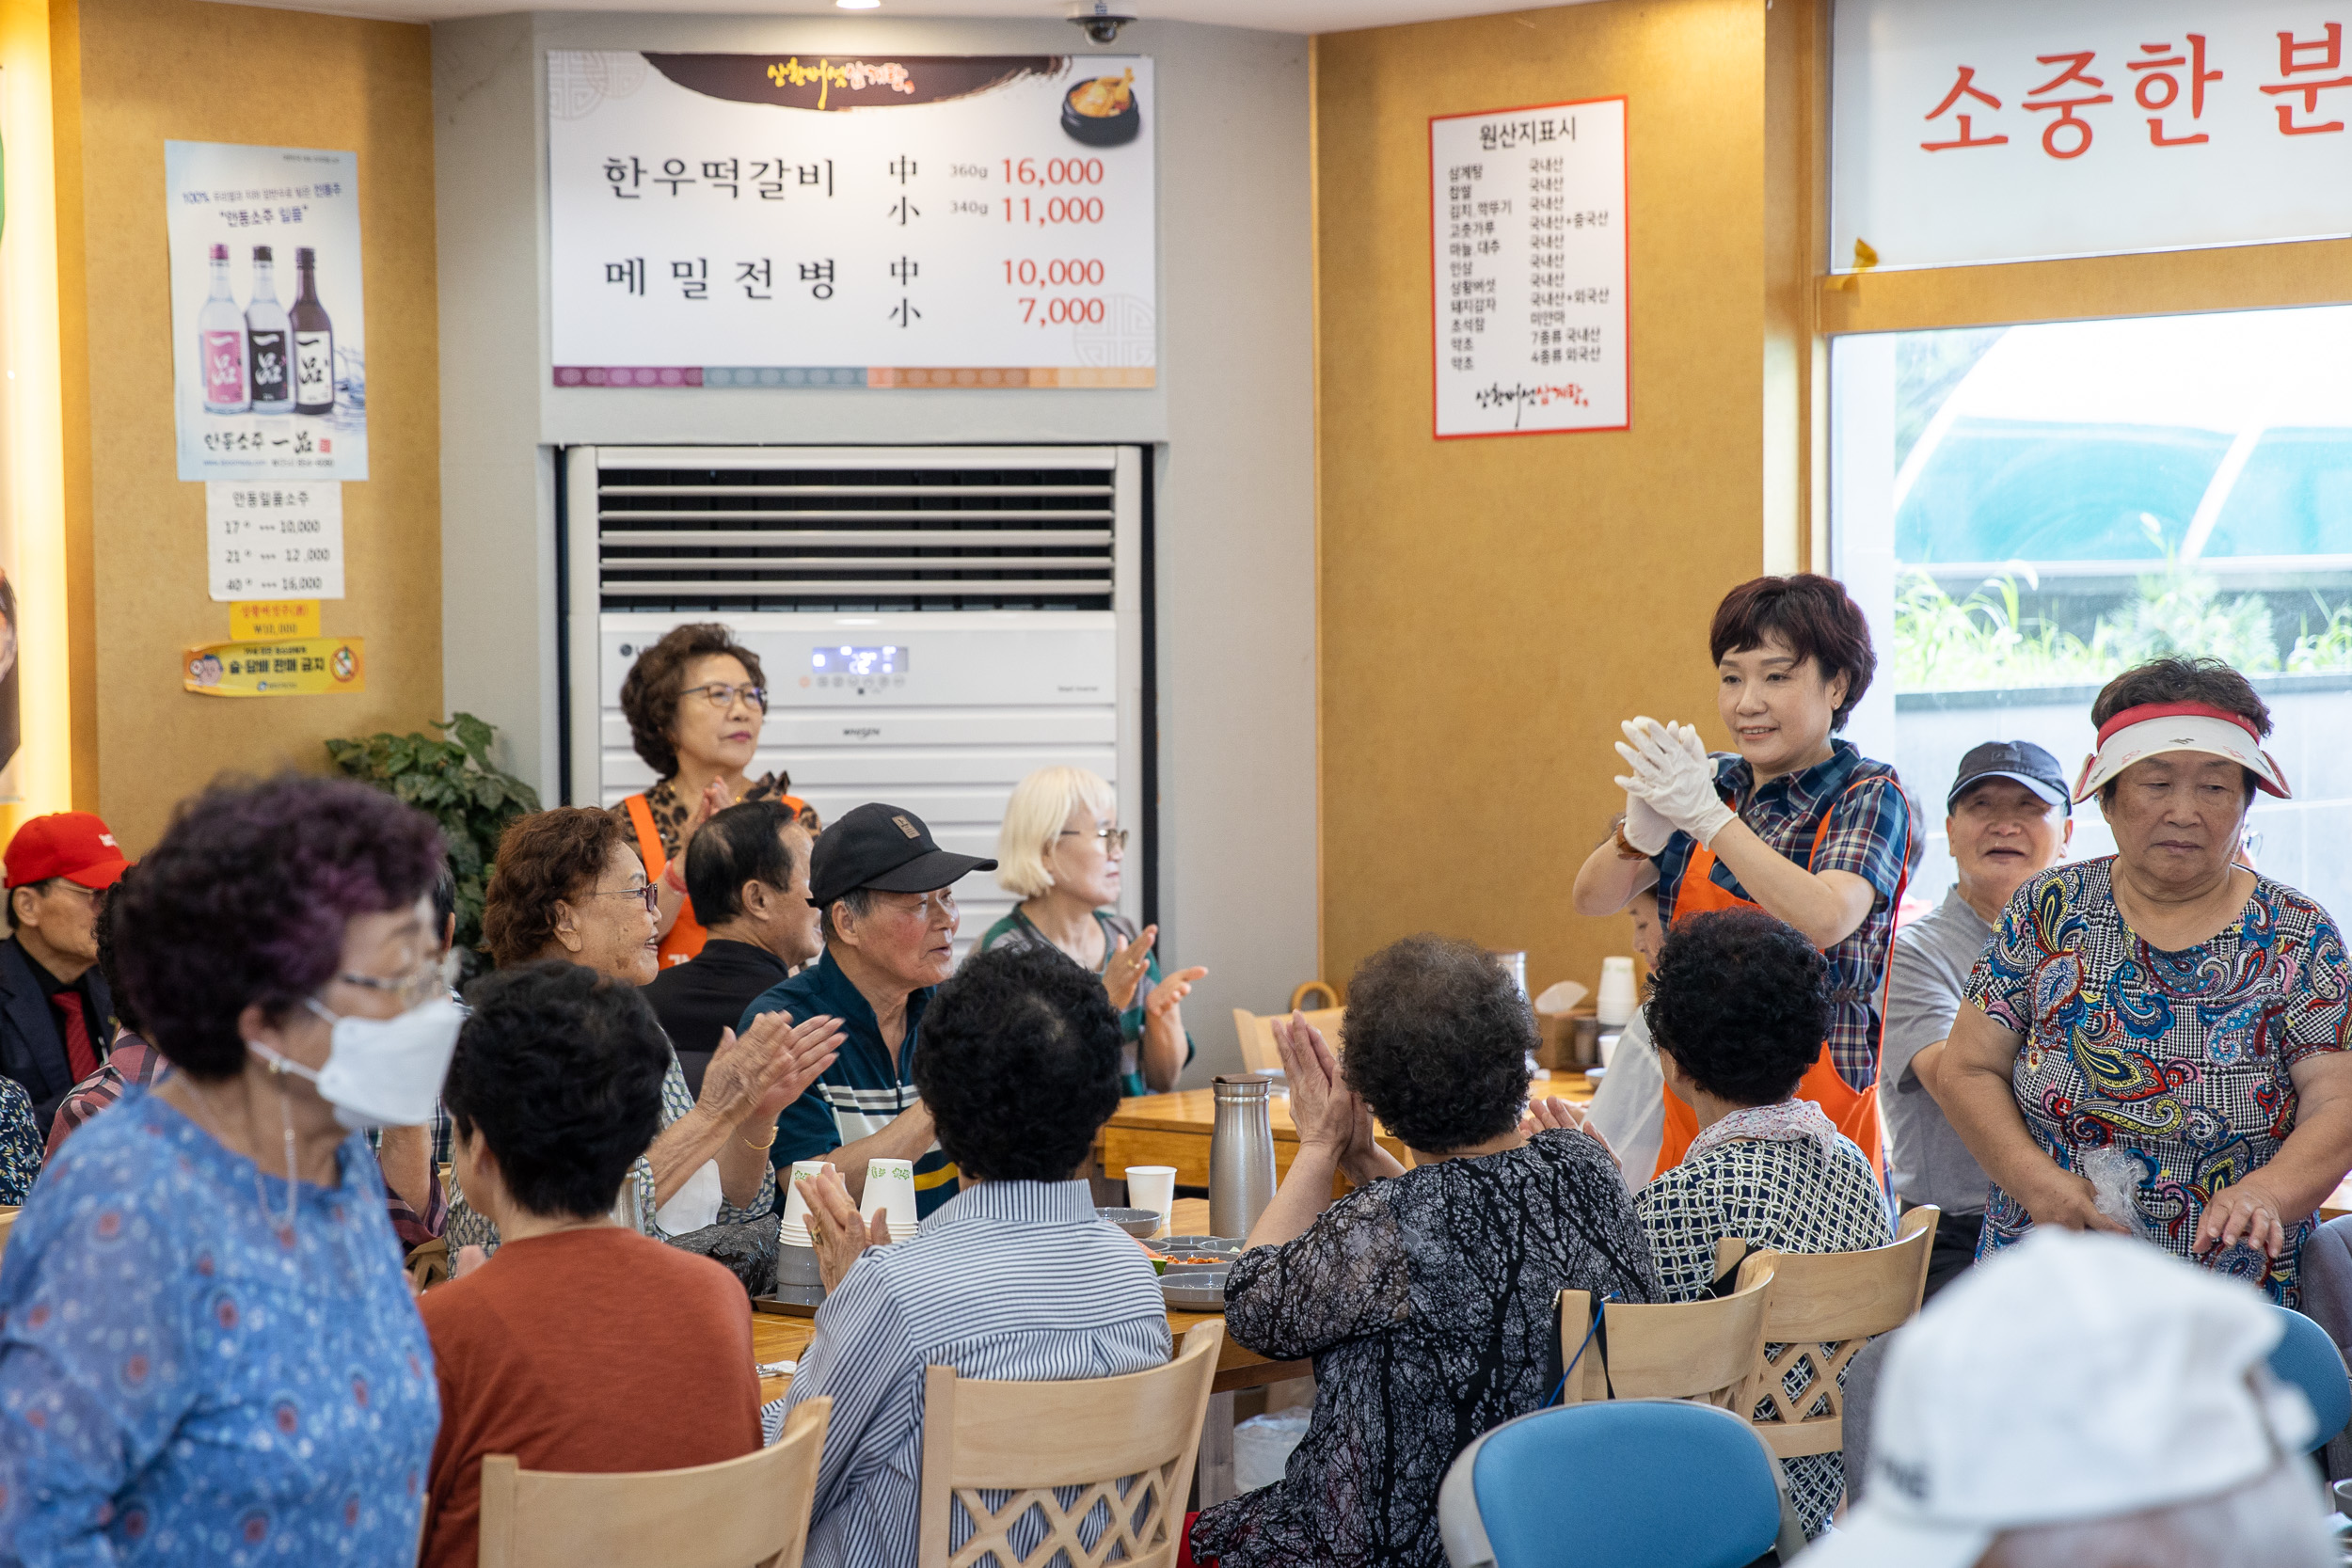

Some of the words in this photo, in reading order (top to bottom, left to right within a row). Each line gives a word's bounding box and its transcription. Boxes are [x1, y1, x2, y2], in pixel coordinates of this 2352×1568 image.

[1920, 32, 2223, 160] 소중한
[2260, 21, 2352, 135] 분
[1480, 116, 1577, 150] 원산지표시
[603, 156, 834, 200] 한우떡갈비
[888, 155, 917, 185] 中
[950, 164, 988, 179] 360g
[1002, 157, 1104, 188] 16,000
[1449, 163, 1484, 182] 삼계탕
[1529, 157, 1564, 173] 국내산
[1529, 176, 1564, 193] 국내산
[887, 196, 921, 226] 小
[950, 200, 988, 215] 340g
[1002, 197, 1104, 227] 11,000
[1529, 195, 1565, 212] 국내산
[1477, 239, 1500, 255] 대추
[1529, 233, 1565, 250] 국내산
[1530, 252, 1565, 269] 국내산
[890, 256, 918, 286] 中
[1003, 259, 1104, 289] 10,000
[1530, 271, 1565, 289] 국내산
[888, 298, 921, 327] 小
[1018, 297, 1104, 327] 7,000
[1530, 309, 1565, 327] 미얀마
[1531, 329, 1563, 346] 7종류
[1565, 325, 1601, 344] 국내산
[1565, 344, 1601, 364] 외국산
[204, 431, 264, 452] 안동소주
[232, 490, 310, 508] 안동일품소주
[279, 519, 322, 534] 10,000
[281, 576, 323, 591] 16,000
